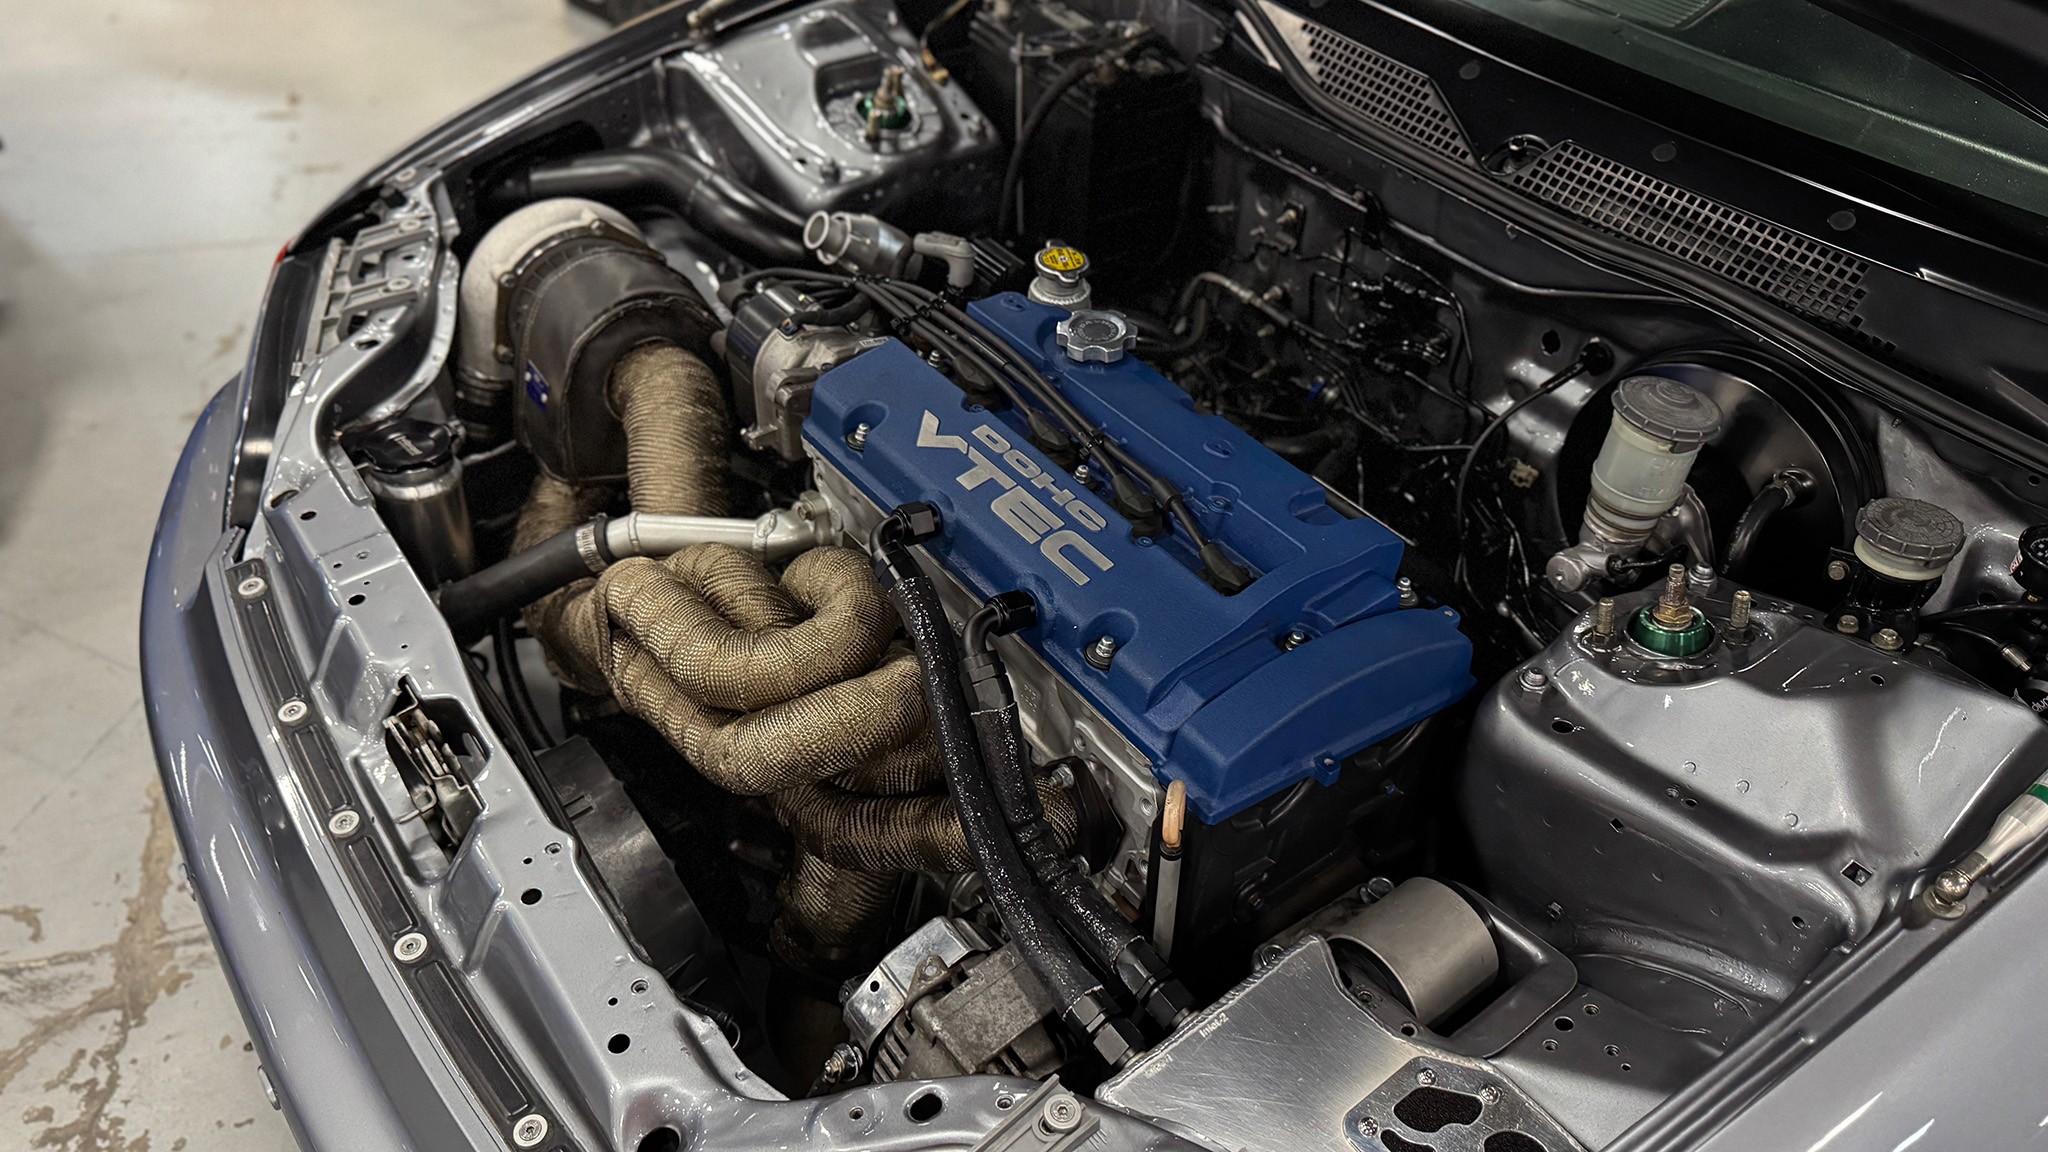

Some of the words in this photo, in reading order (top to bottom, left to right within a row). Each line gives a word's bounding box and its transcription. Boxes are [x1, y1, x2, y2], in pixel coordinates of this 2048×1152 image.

[916, 409, 1115, 587] VTEC
[971, 424, 1107, 531] DOHC
[1199, 1012, 1229, 1038] Inlet-2
